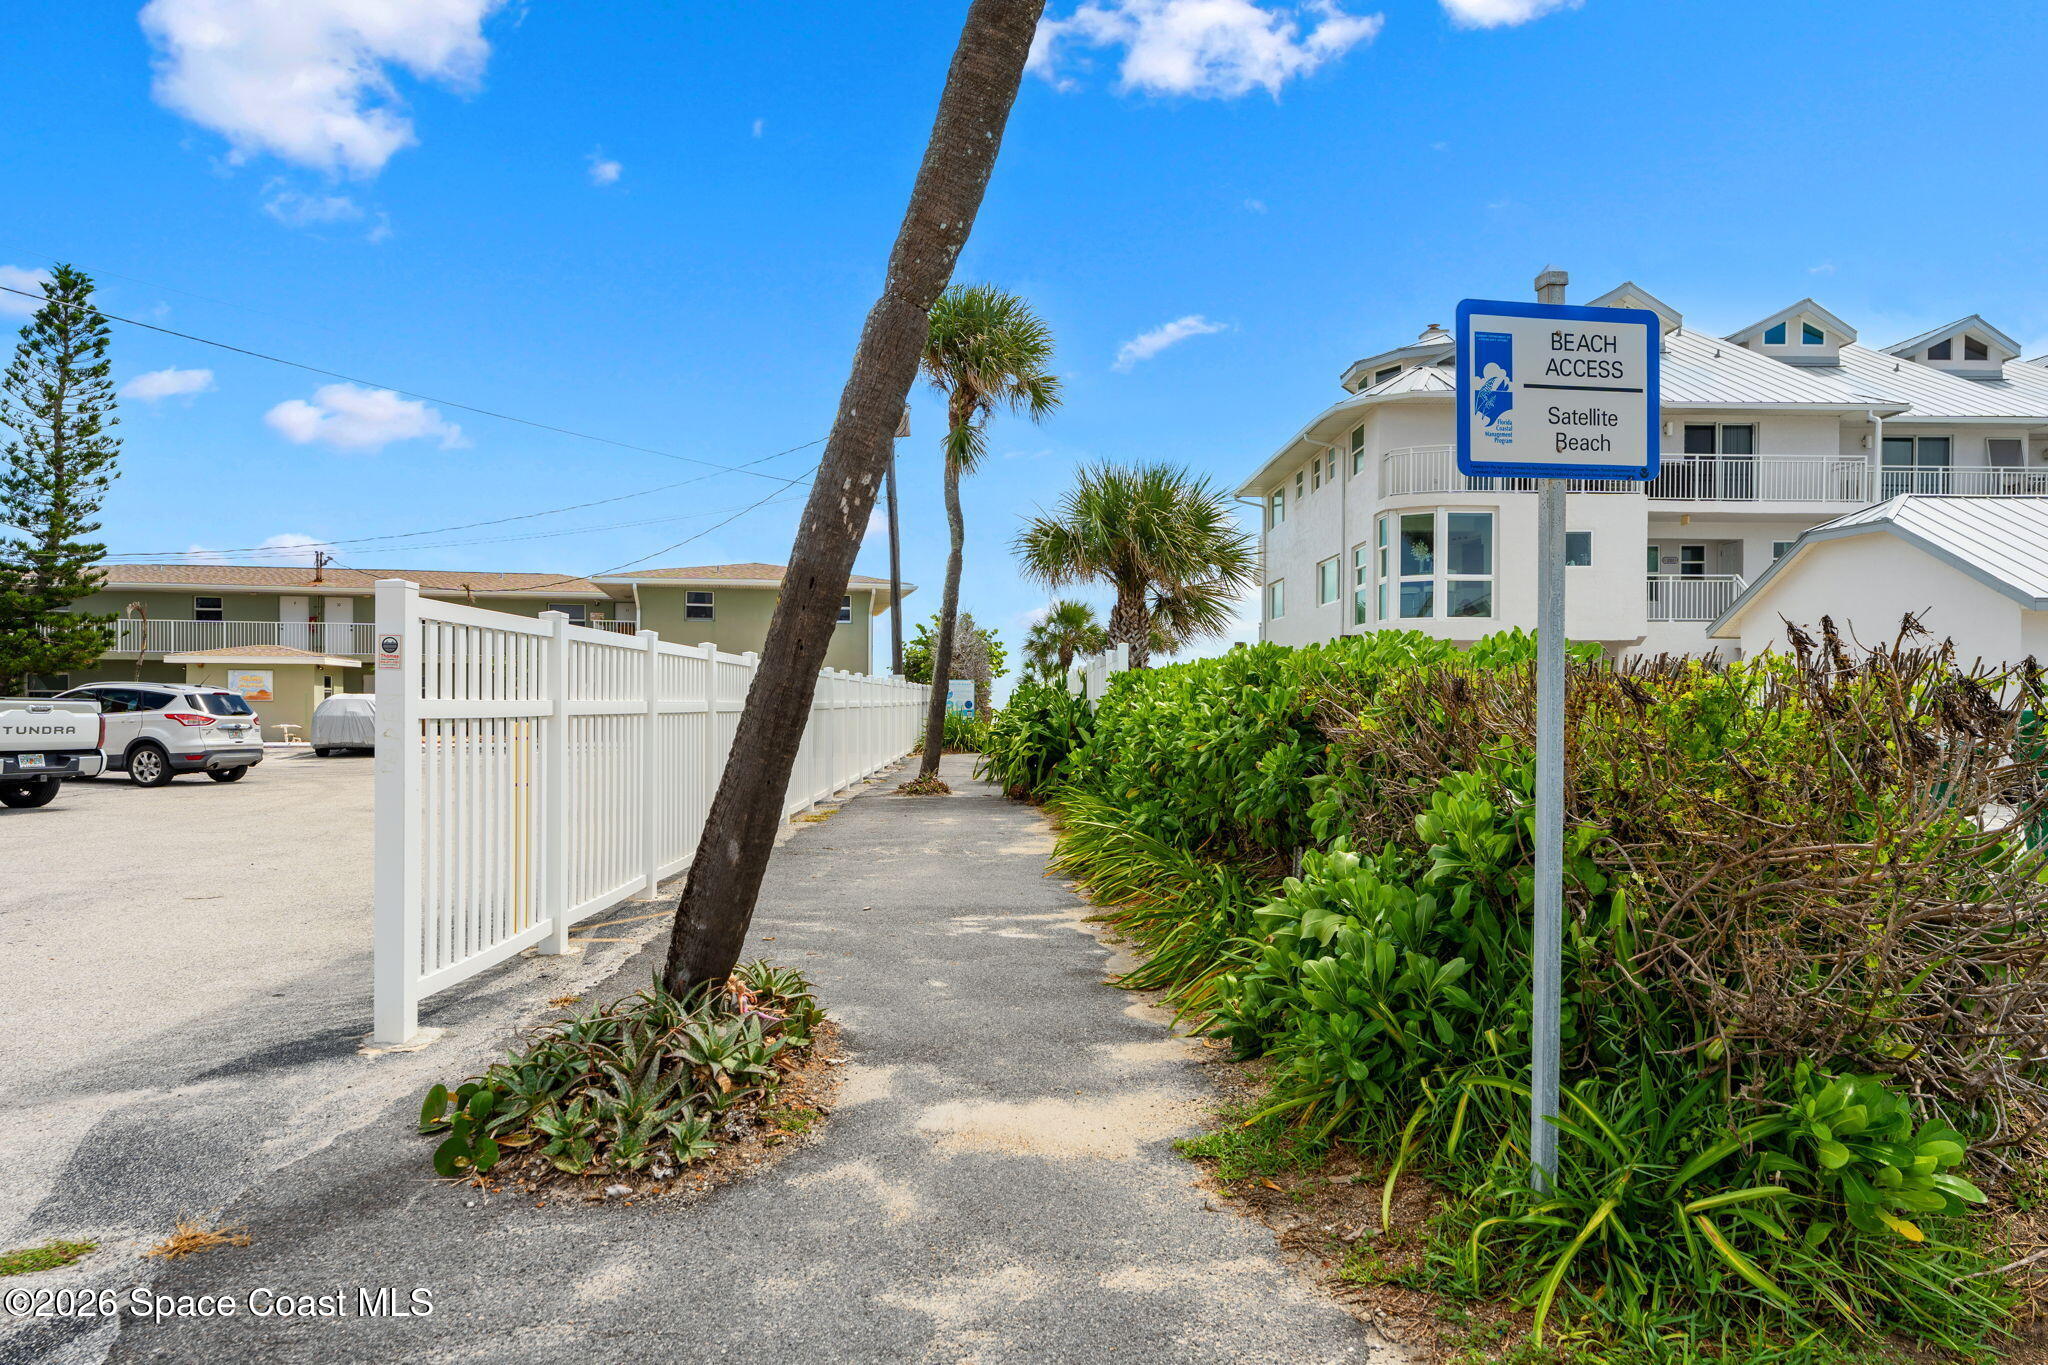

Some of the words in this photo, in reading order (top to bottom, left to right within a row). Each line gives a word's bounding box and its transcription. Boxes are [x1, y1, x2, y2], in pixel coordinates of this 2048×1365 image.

[1551, 332, 1617, 354] BEACH
[1545, 358, 1624, 379] ACCESS
[1548, 406, 1618, 427] Satellite
[1494, 437, 1513, 445] Program
[1556, 432, 1611, 452] Beach
[3, 726, 76, 735] TUNDRA
